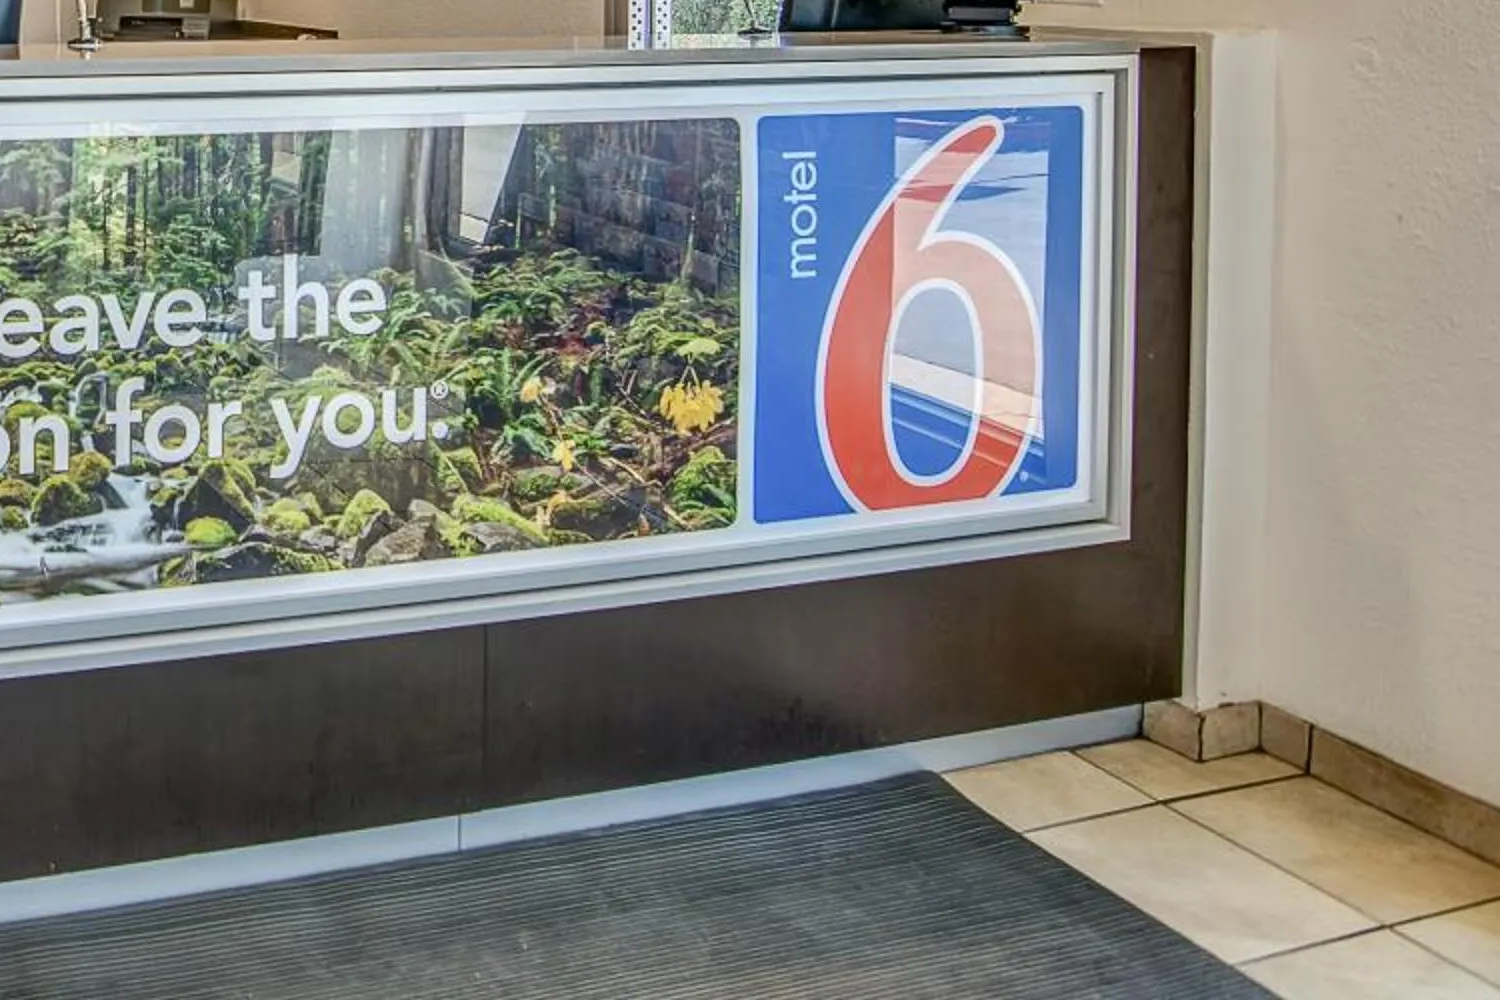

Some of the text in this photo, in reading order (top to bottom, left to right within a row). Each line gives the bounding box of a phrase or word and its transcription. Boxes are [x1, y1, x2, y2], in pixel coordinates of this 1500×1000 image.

[782, 149, 819, 279] motel
[237, 254, 387, 342] the
[815, 115, 1043, 511] 6
[105, 375, 244, 466] for
